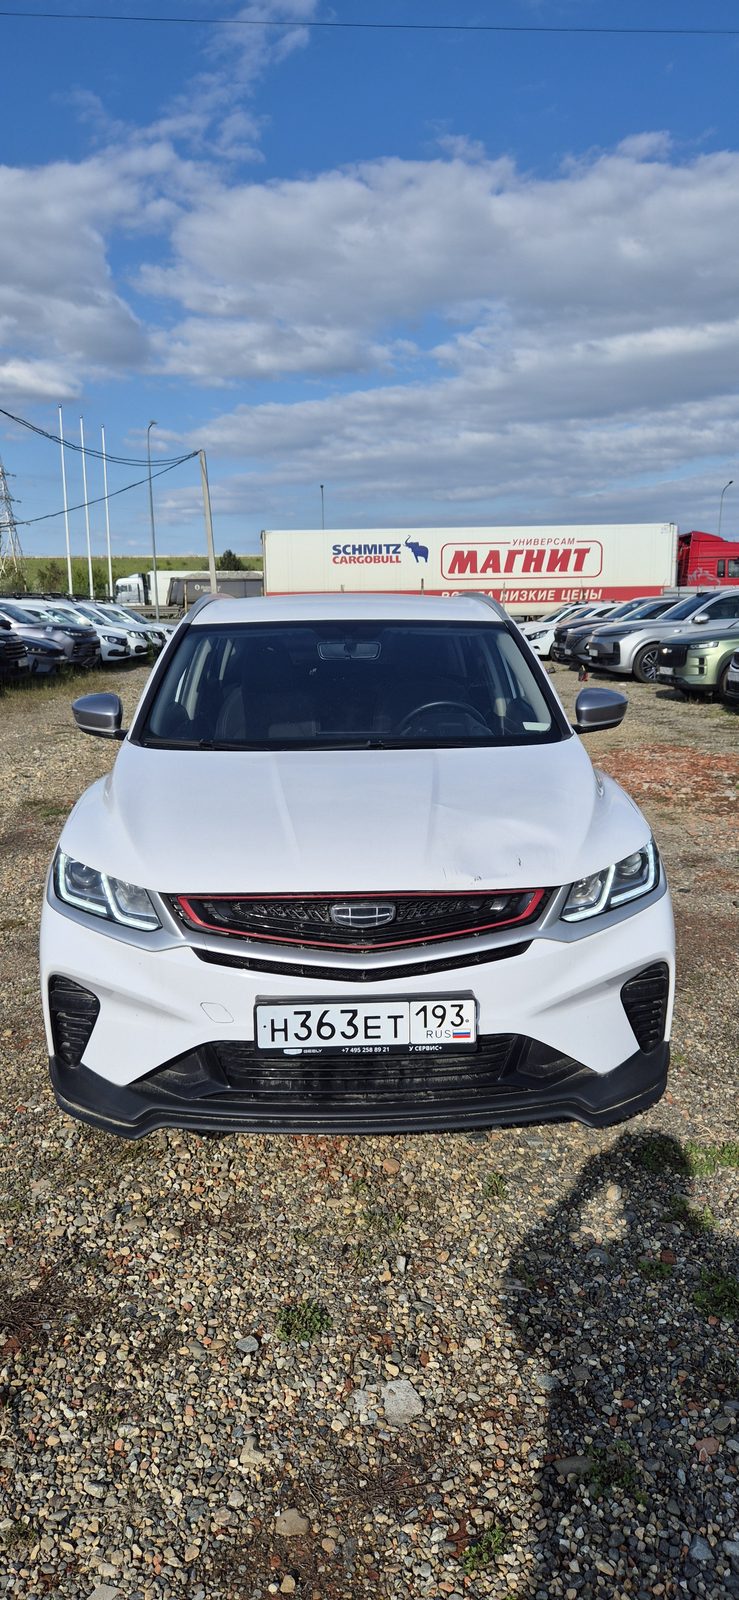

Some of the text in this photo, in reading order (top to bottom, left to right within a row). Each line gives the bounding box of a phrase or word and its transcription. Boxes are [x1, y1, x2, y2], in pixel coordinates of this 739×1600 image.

[512, 538, 576, 546] УНИВЕРСАМ
[332, 543, 401, 555] SCHMITZ
[332, 555, 402, 564] CARGOBULL
[447, 547, 591, 574] МАГНИТ
[499, 589, 556, 602] НИЗКИЕ
[561, 588, 603, 602] ЦЕНЫ
[270, 1004, 464, 1042] Н363ЕТ 193
[426, 1029, 452, 1039] RUS
